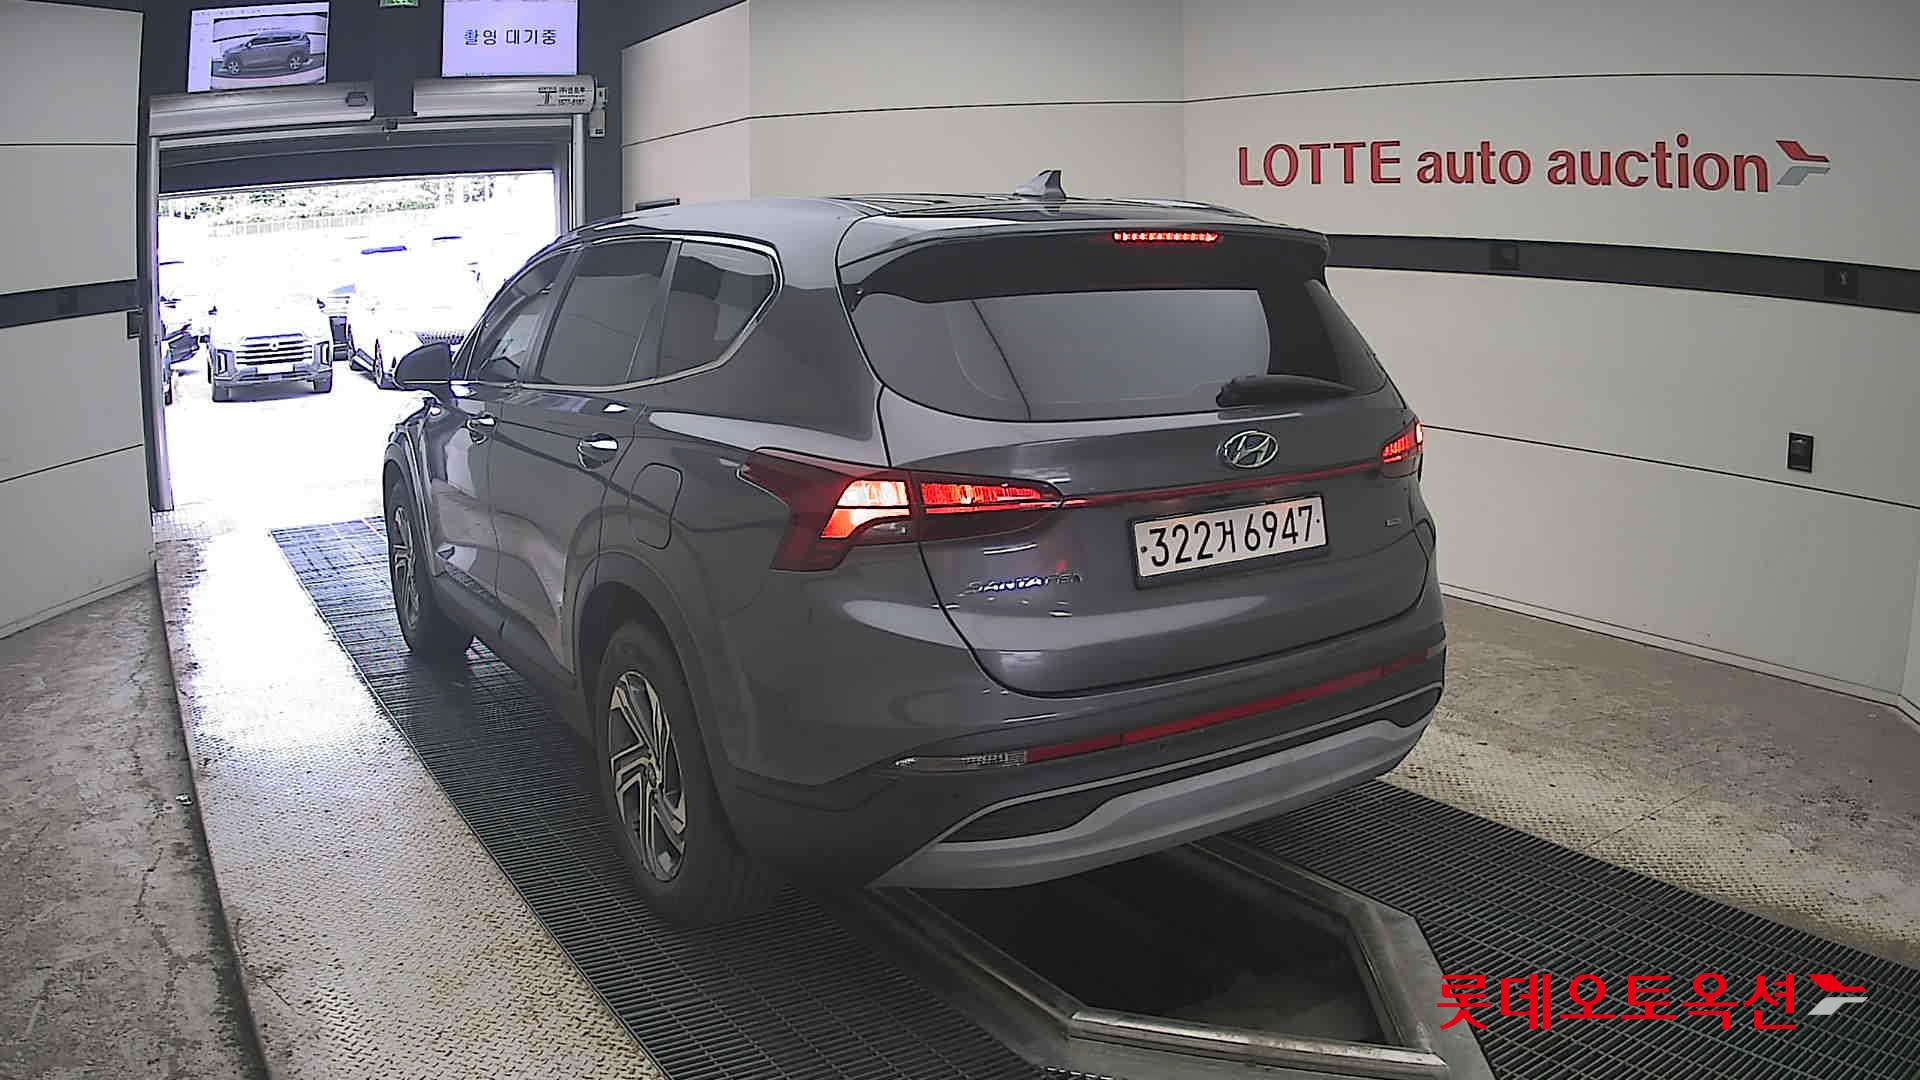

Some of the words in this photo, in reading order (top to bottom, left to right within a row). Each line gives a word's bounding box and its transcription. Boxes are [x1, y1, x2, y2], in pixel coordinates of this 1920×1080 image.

[505, 28, 557, 46] 대기중
[1238, 139, 1401, 186] LOTTE
[1417, 139, 1531, 185] auto
[1546, 133, 1770, 193] auction
[1149, 518, 1236, 568] 322거
[1244, 504, 1314, 552] 6947
